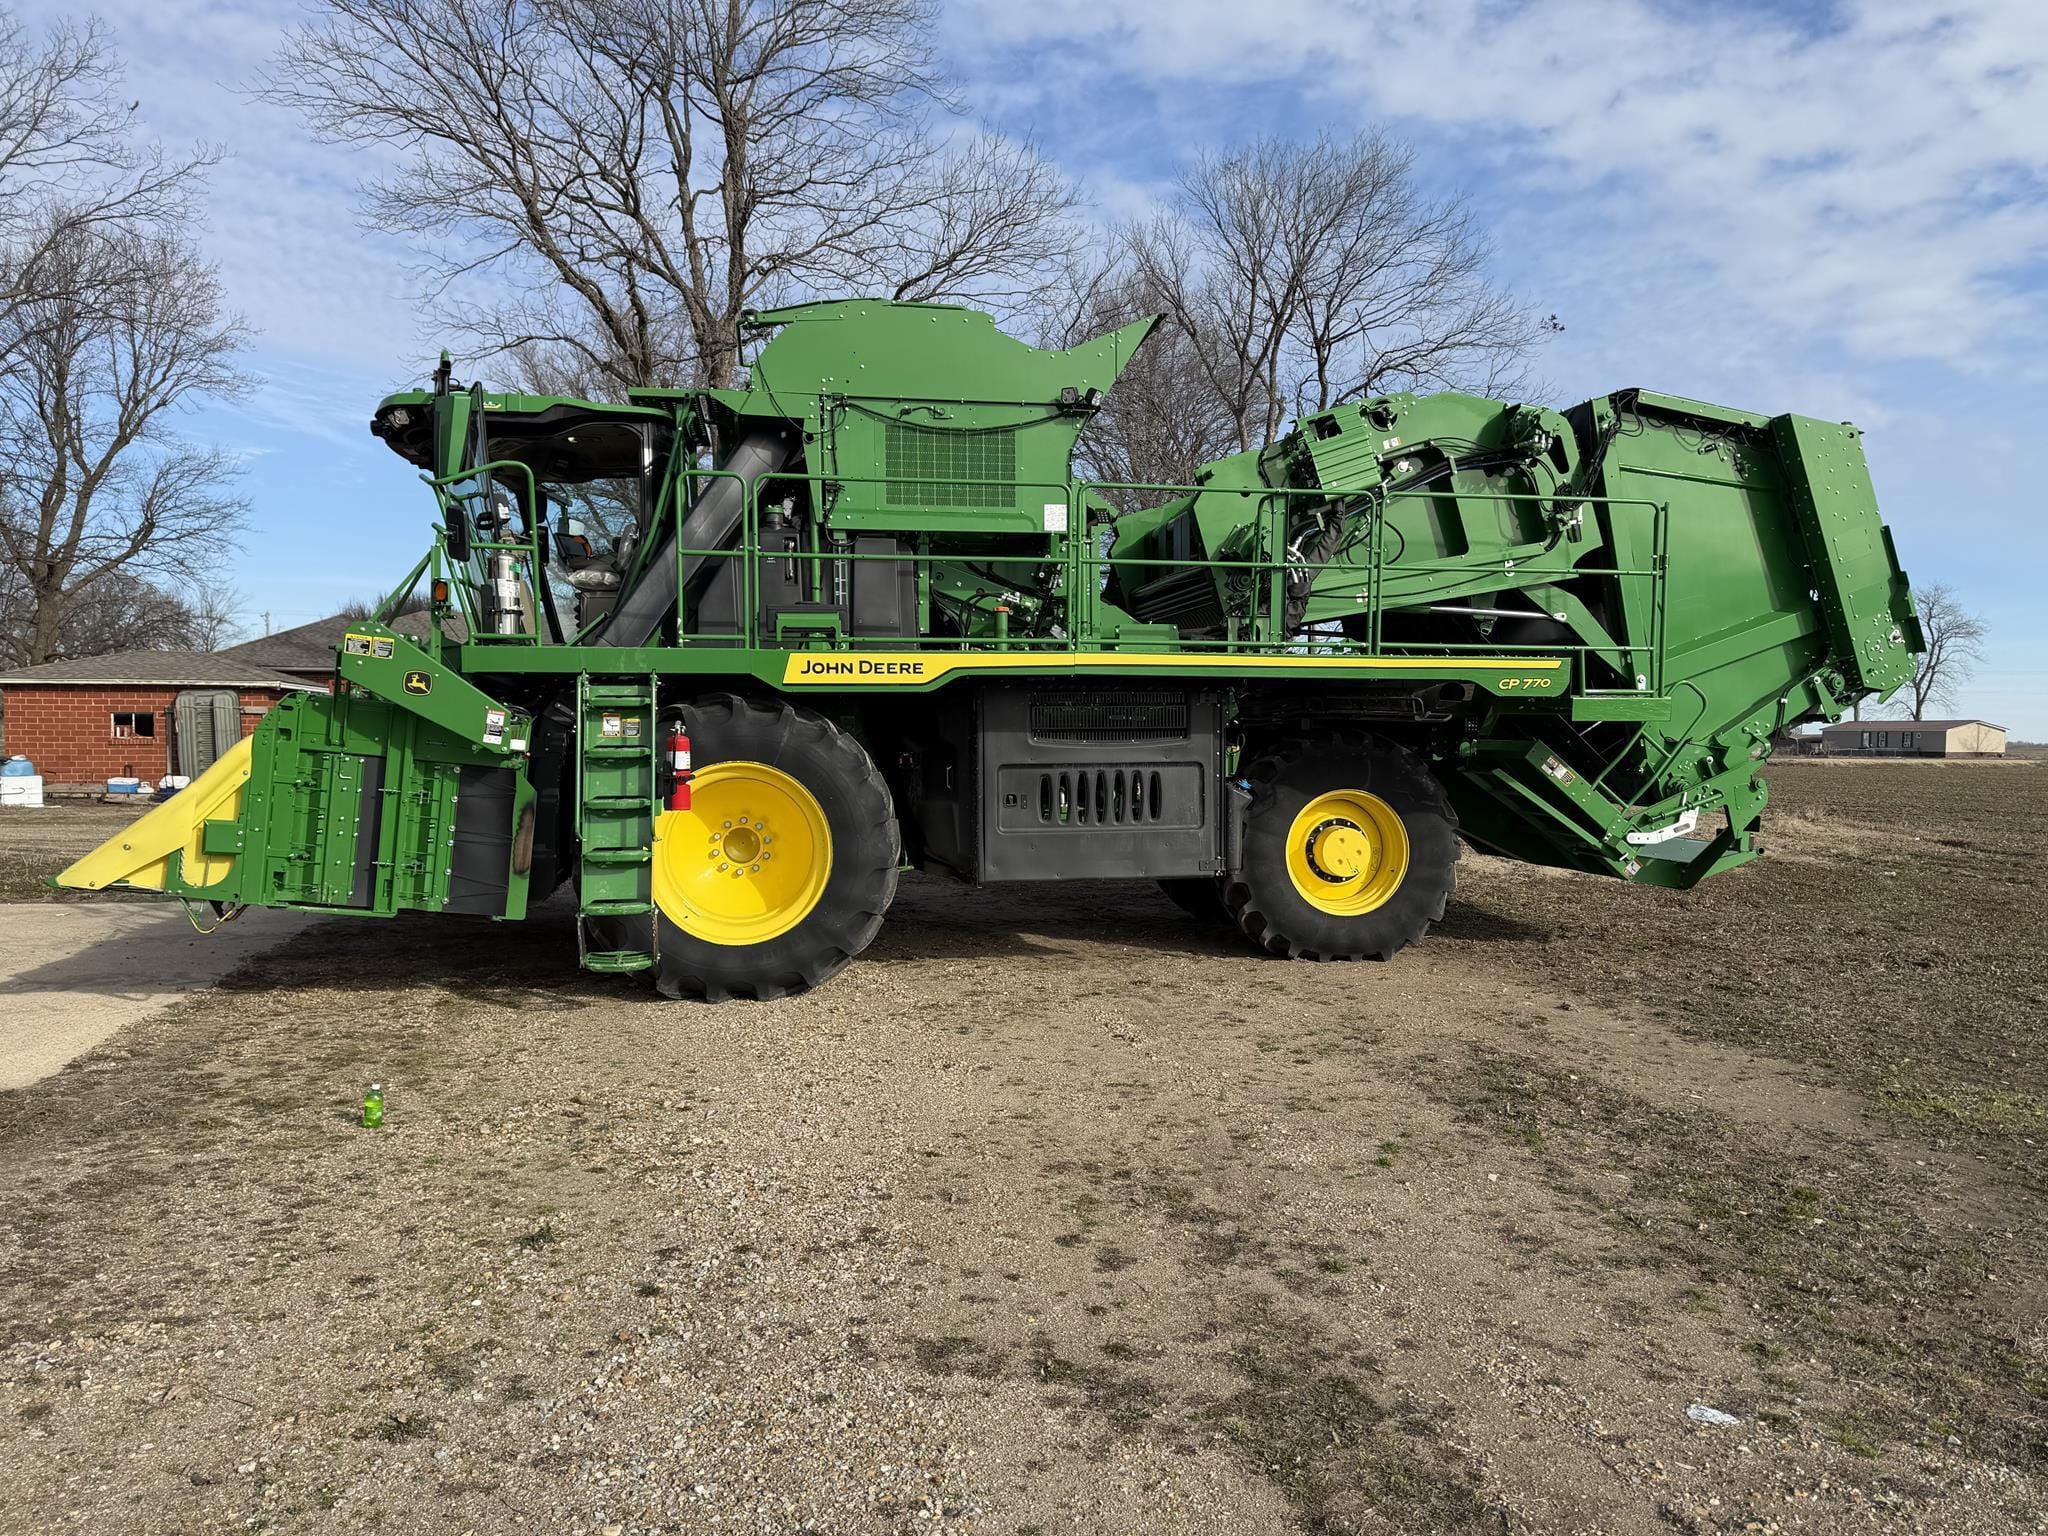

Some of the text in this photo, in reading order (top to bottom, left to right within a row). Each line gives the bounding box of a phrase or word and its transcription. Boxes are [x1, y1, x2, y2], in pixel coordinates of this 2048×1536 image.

[800, 660, 924, 674] JOHN DEERE
[1499, 678, 1551, 690] CP 770
